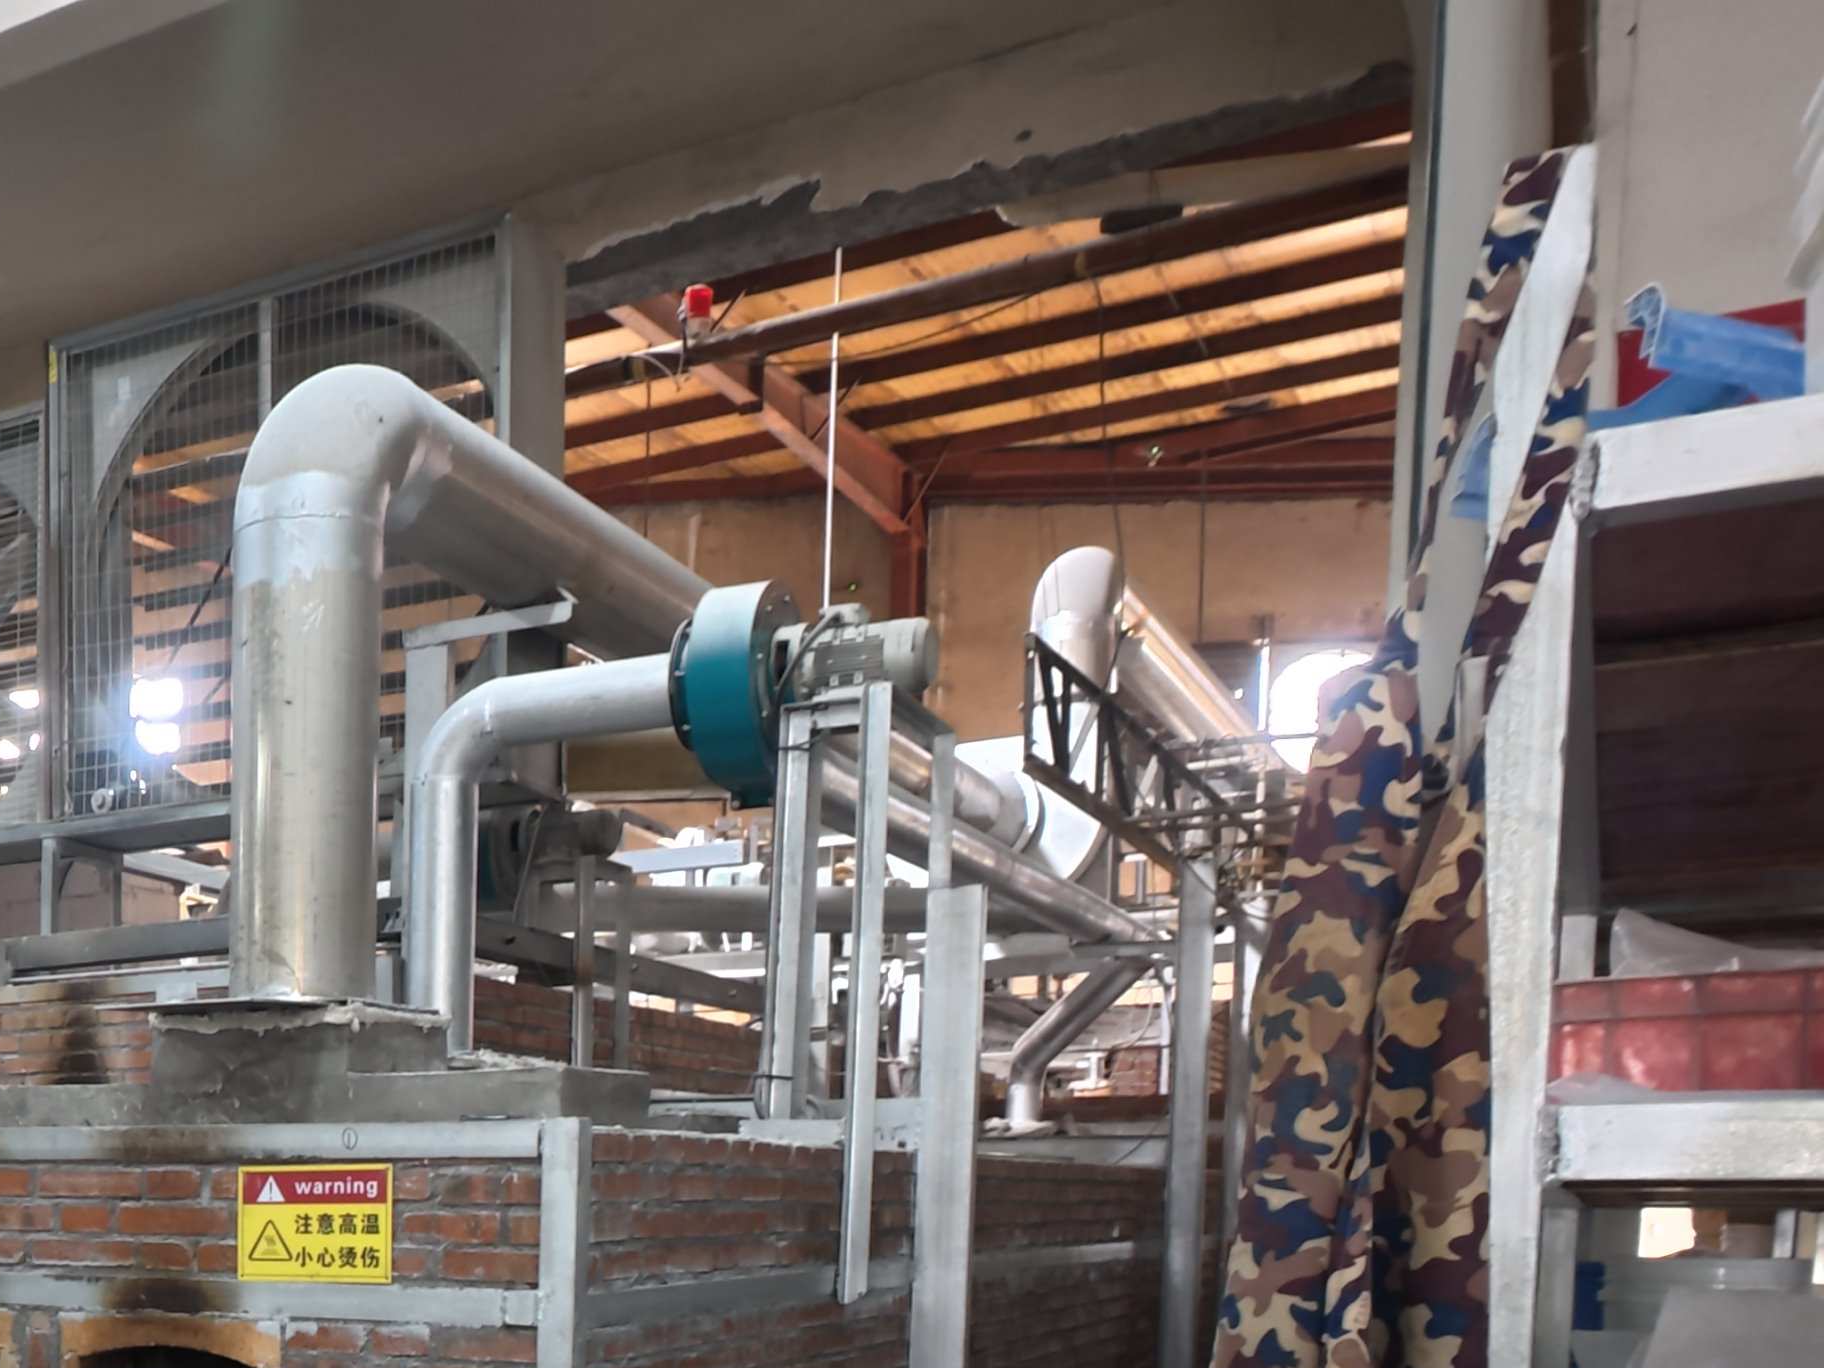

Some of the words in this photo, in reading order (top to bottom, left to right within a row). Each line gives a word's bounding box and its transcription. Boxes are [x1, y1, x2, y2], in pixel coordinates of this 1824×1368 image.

[294, 1176, 379, 1198] warning
[294, 1212, 381, 1236] 注意高温
[294, 1246, 381, 1269] 小心烫伤
